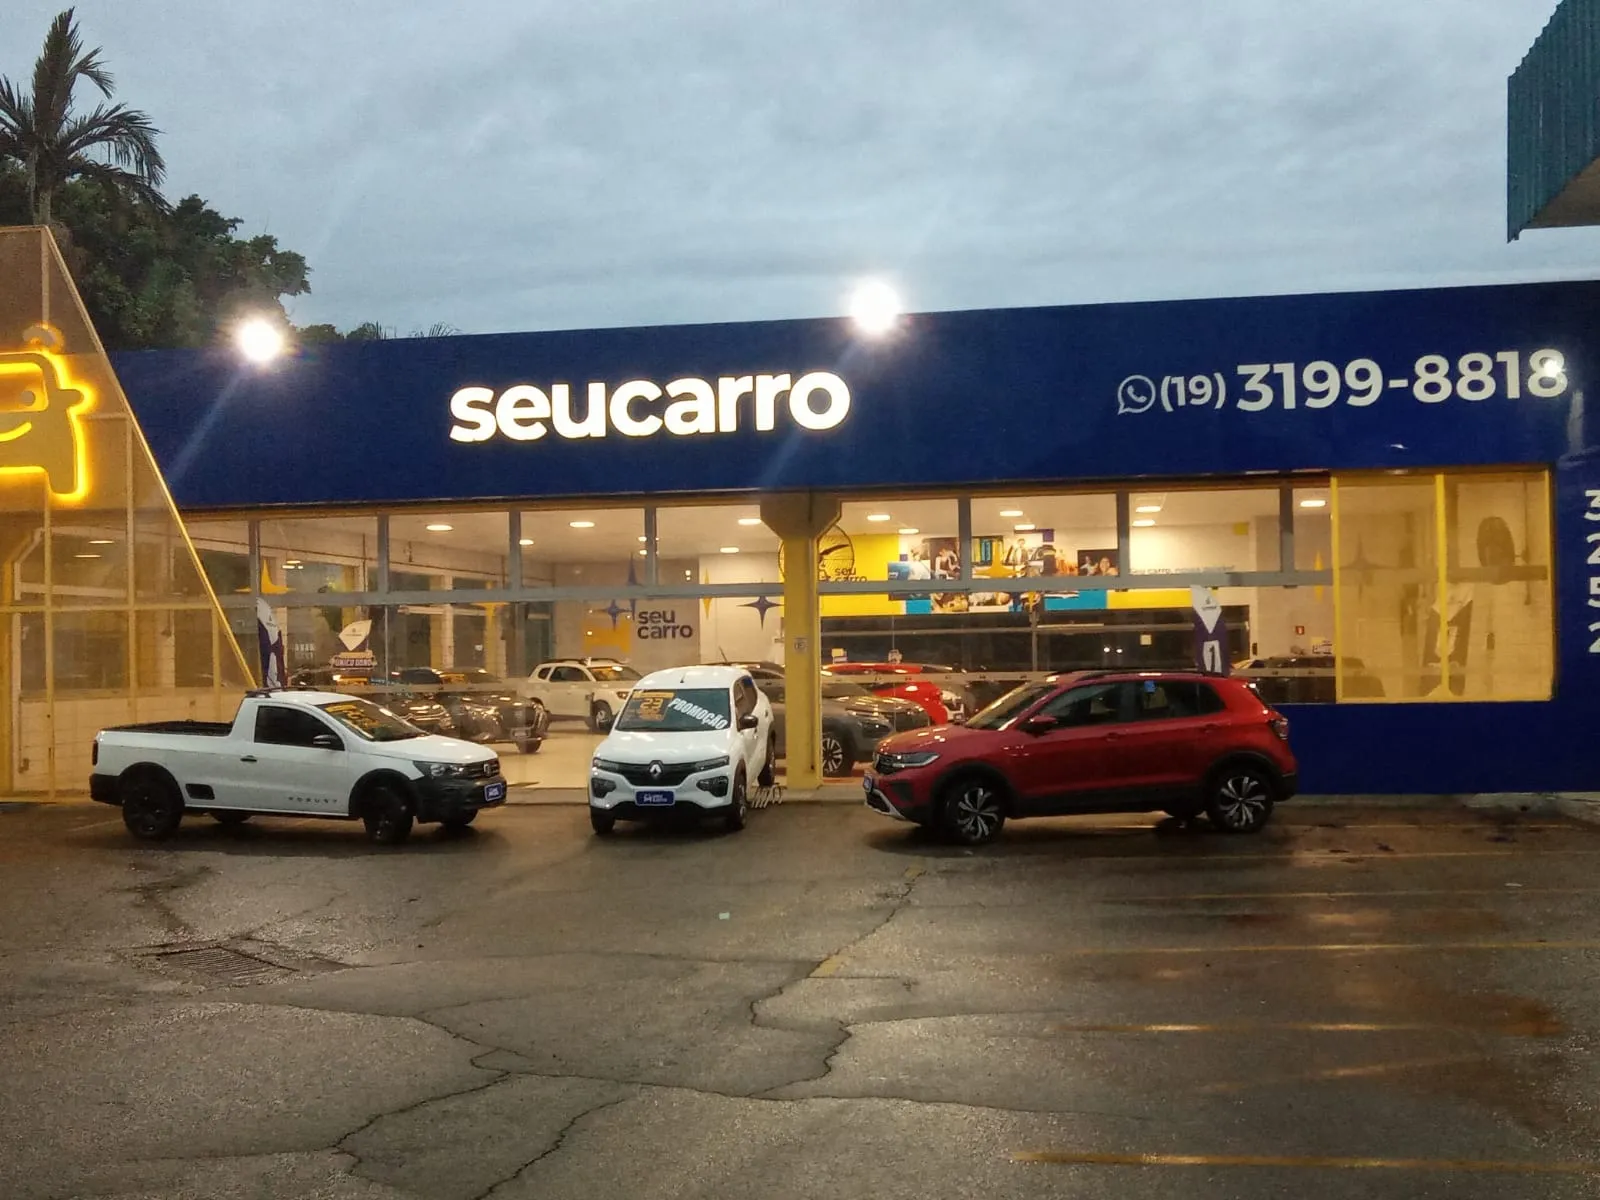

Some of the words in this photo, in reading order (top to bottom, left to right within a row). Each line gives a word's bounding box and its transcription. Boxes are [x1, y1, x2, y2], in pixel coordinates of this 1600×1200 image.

[1160, 373, 1227, 412] (19)
[1237, 348, 1568, 412] 3199-8818
[449, 371, 851, 443] seucarro
[637, 625, 693, 639] carro
[638, 610, 676, 624] seu
[668, 697, 729, 730] PROMOÇÃO
